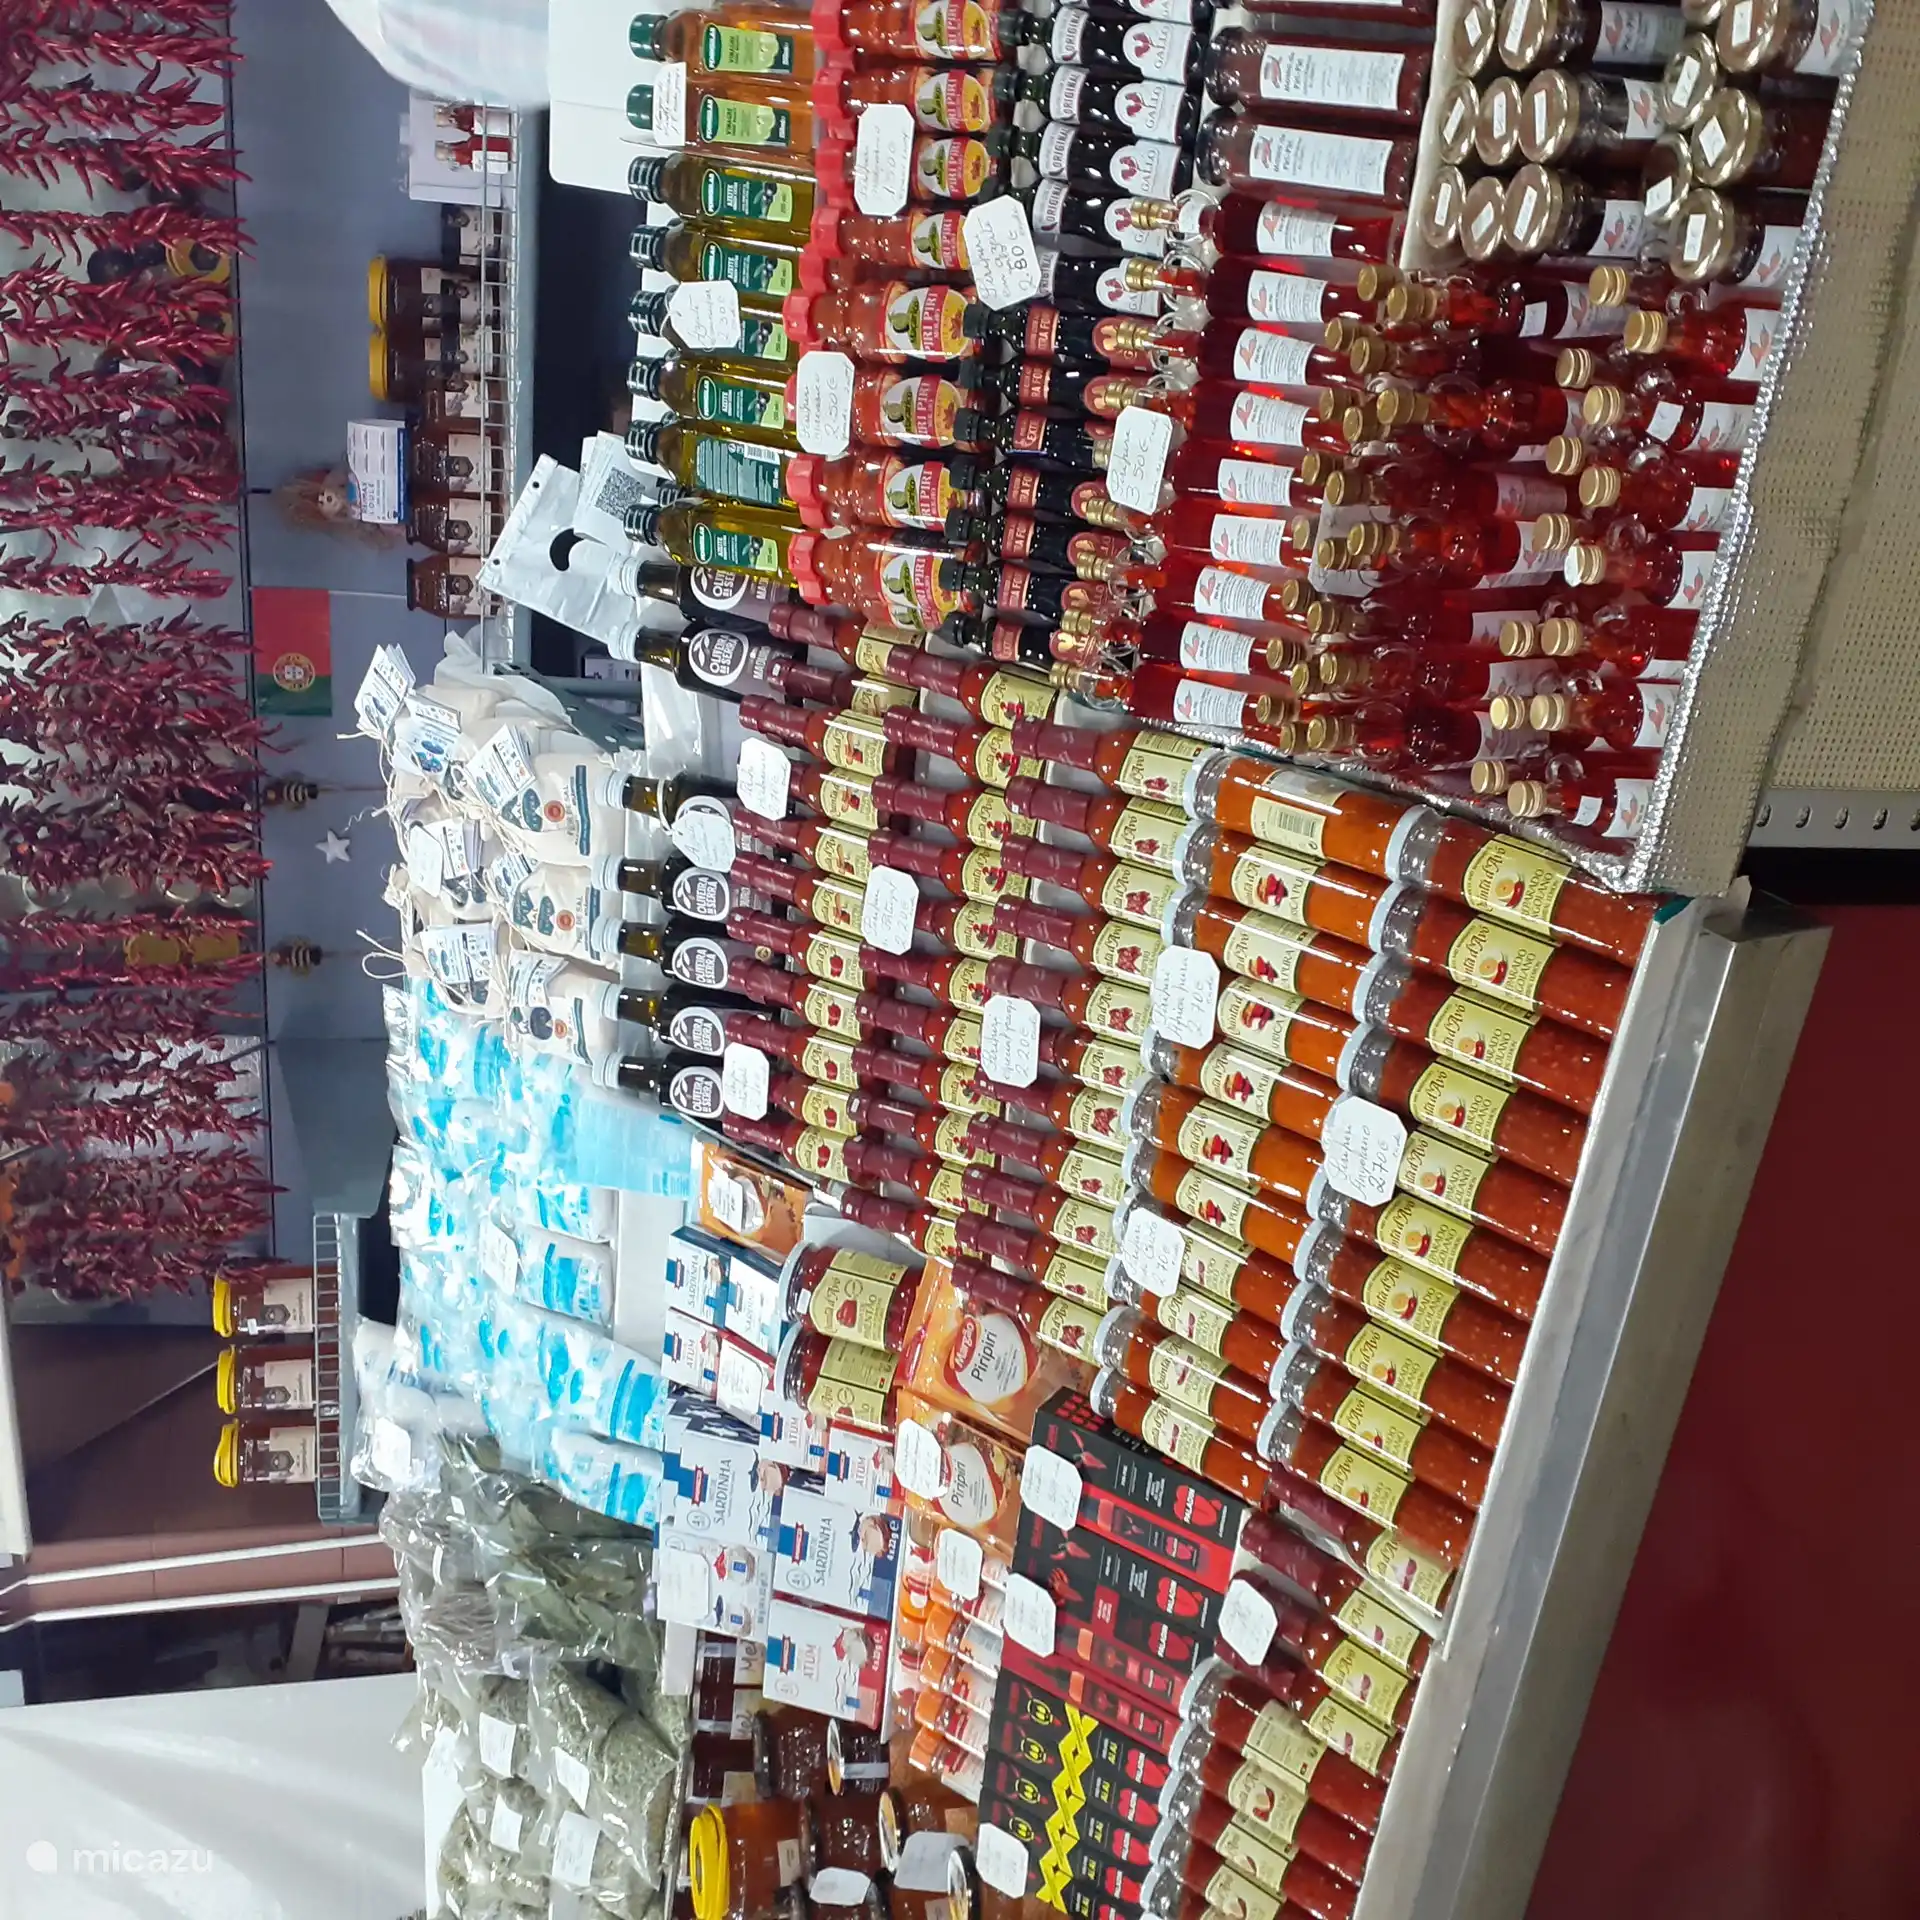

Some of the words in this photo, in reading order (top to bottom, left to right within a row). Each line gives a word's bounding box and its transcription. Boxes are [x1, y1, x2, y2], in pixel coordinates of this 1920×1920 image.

[1156, 25, 1170, 69] GALLO
[945, 79, 958, 105] PIRI
[1062, 73, 1080, 115] ORIGINAL
[1144, 86, 1164, 129] GALLO
[1140, 149, 1157, 192] GALLO
[924, 292, 938, 320] PIRI
[923, 325, 933, 351] PIRI
[918, 382, 930, 411] PIRI
[920, 470, 933, 496] PIRI
[712, 570, 724, 597] OLIV
[723, 572, 735, 587] SER
[915, 558, 925, 586] PIRI
[710, 635, 728, 673] OLIVEIRA
[721, 638, 738, 665] SERRA
[1481, 847, 1507, 879] d'Avó
[696, 876, 709, 913] OLIVEIRA
[706, 880, 718, 909] SERRA
[1467, 926, 1489, 957] d'Avó
[695, 949, 706, 982] OLIVEIRA
[705, 953, 716, 978] SERRA
[1281, 950, 1295, 976] PURA
[1227, 1003, 1241, 1035] Quinta
[1447, 1003, 1466, 1035] d'Avó
[692, 1076, 703, 1112] OLIVEIRA
[702, 1080, 713, 1106] SERRA
[1429, 1070, 1448, 1100] d'Avó
[1410, 1139, 1429, 1171] d'Avó
[687, 1254, 699, 1308] SARDINHA
[825, 1277, 841, 1306] d'Avó
[687, 1339, 695, 1368] ATUM
[953, 1321, 974, 1369] Margão
[971, 1328, 997, 1382] Piripiri
[1361, 1331, 1381, 1362] d'Avó
[787, 1416, 799, 1447] ATUM
[855, 1456, 867, 1487] ATUM
[950, 1460, 967, 1507] Piripiri
[713, 1459, 731, 1526] SARDINHA
[1184, 1488, 1195, 1523] PALADIN
[813, 1517, 833, 1586] SARDINHA
[1166, 1579, 1177, 1613] PALADIN
[1157, 1624, 1168, 1658] PALADIN
[803, 1643, 817, 1679] ATUM
